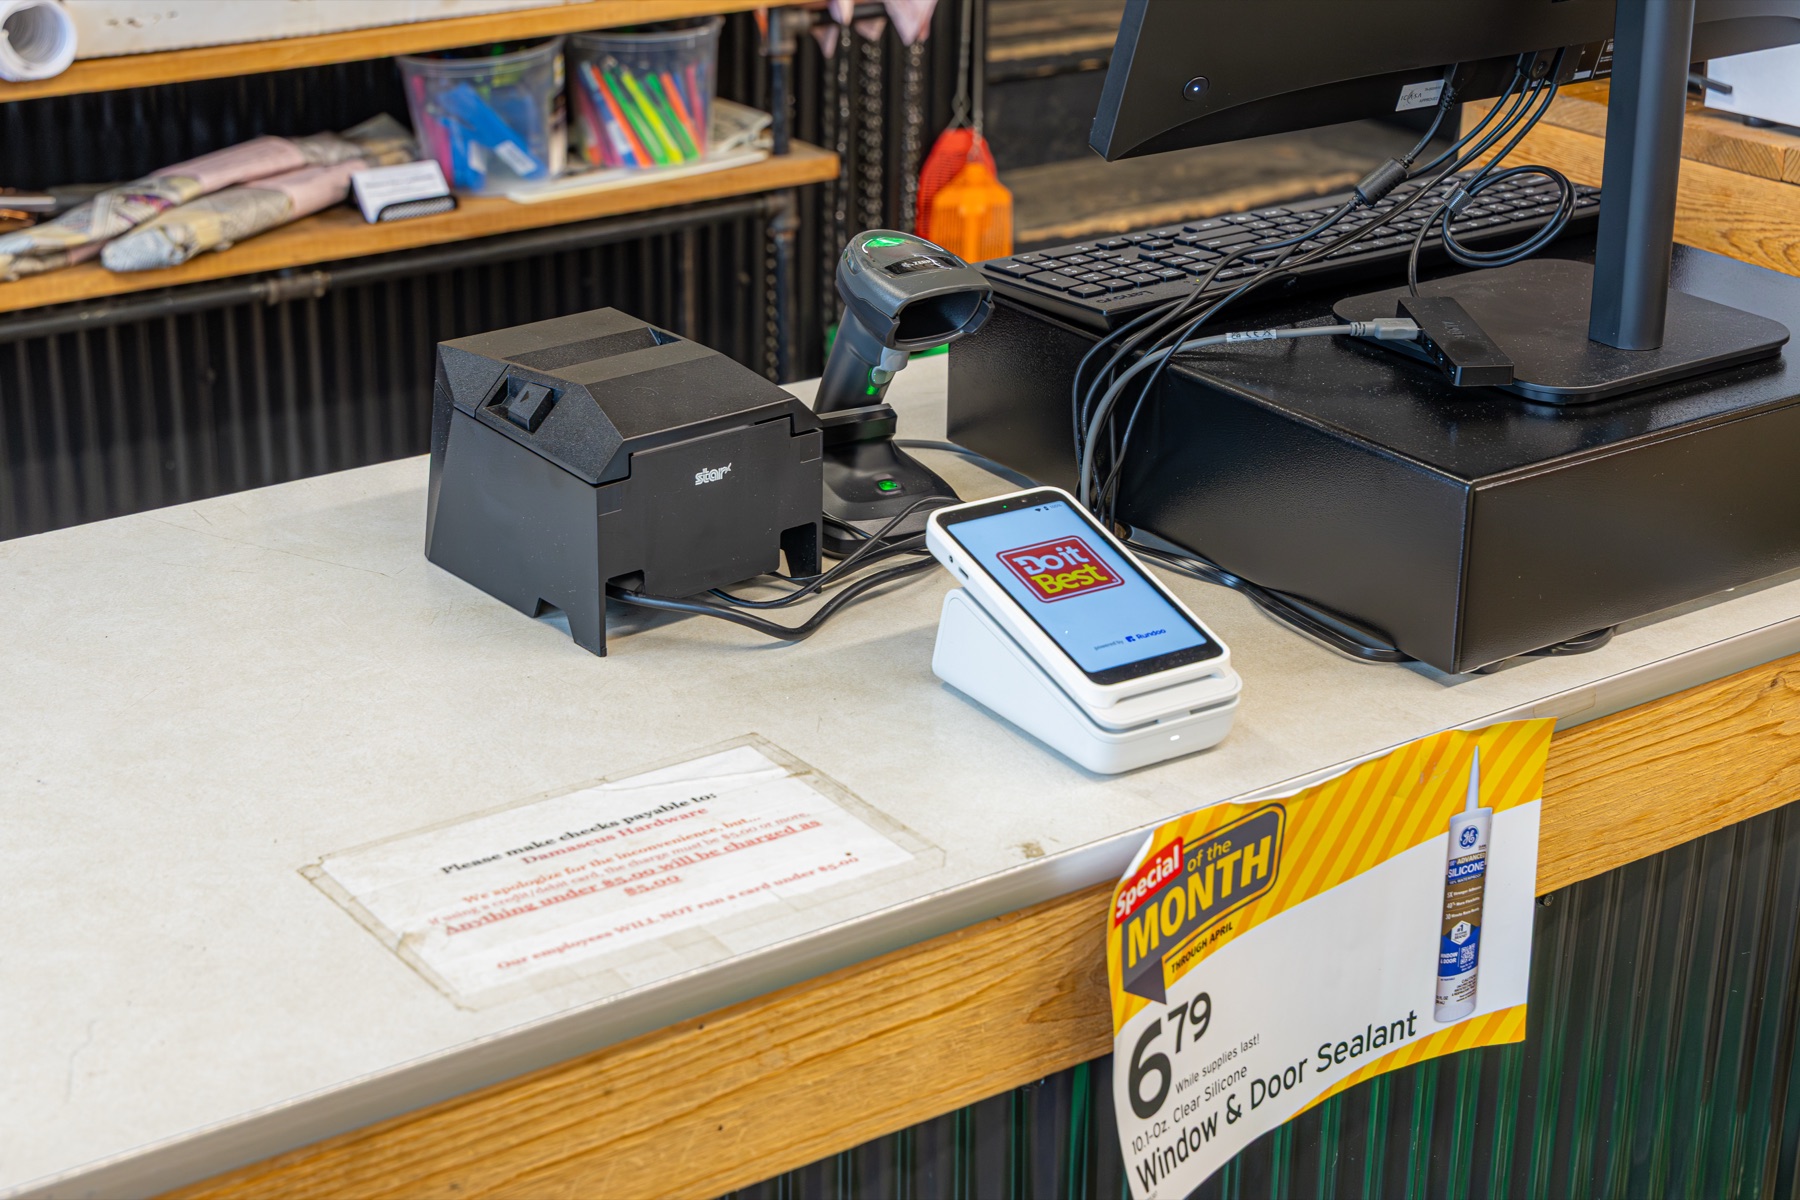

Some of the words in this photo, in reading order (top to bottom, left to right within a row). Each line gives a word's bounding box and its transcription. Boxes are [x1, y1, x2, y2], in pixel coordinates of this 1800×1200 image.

[1030, 564, 1108, 594] Best
[440, 852, 502, 875] Please
[505, 838, 558, 857] make
[559, 818, 620, 841] checks
[622, 800, 690, 825] payable
[691, 792, 717, 806] to:
[520, 834, 616, 865] Damascus
[617, 806, 710, 837] Hardware
[1187, 848, 1204, 872] of
[1206, 840, 1232, 862] the
[444, 898, 538, 936] Anything
[542, 882, 598, 907] under
[659, 852, 696, 873] will
[698, 845, 722, 861] be
[723, 824, 798, 853] charged
[800, 818, 823, 832] as
[462, 891, 490, 904] We
[490, 870, 564, 896] apologize
[564, 862, 586, 876] for
[588, 855, 614, 868] the
[1116, 844, 1180, 919] Special
[1128, 835, 1272, 969] MONTH
[1448, 860, 1485, 878] SILICONE
[496, 956, 528, 970] Our
[532, 932, 614, 960] employees
[614, 916, 659, 935] WILL
[660, 904, 696, 920] NOT
[697, 895, 724, 910] run
[738, 882, 771, 898] card
[772, 870, 816, 886] under
[1170, 937, 1208, 974] THROUGH
[1208, 922, 1234, 944] APRIL
[1175, 1072, 1200, 1094] While
[1202, 1047, 1238, 1078] supplies
[1240, 1033, 1260, 1053] last!
[1132, 1120, 1170, 1155] 10.1-Oz.
[1172, 1095, 1200, 1123] Clear
[1204, 1066, 1248, 1102] Silicone
[1136, 1111, 1218, 1194] Window
[1226, 1094, 1242, 1125] &
[1250, 1058, 1308, 1110] Door
[1316, 1009, 1418, 1073] Sealant
